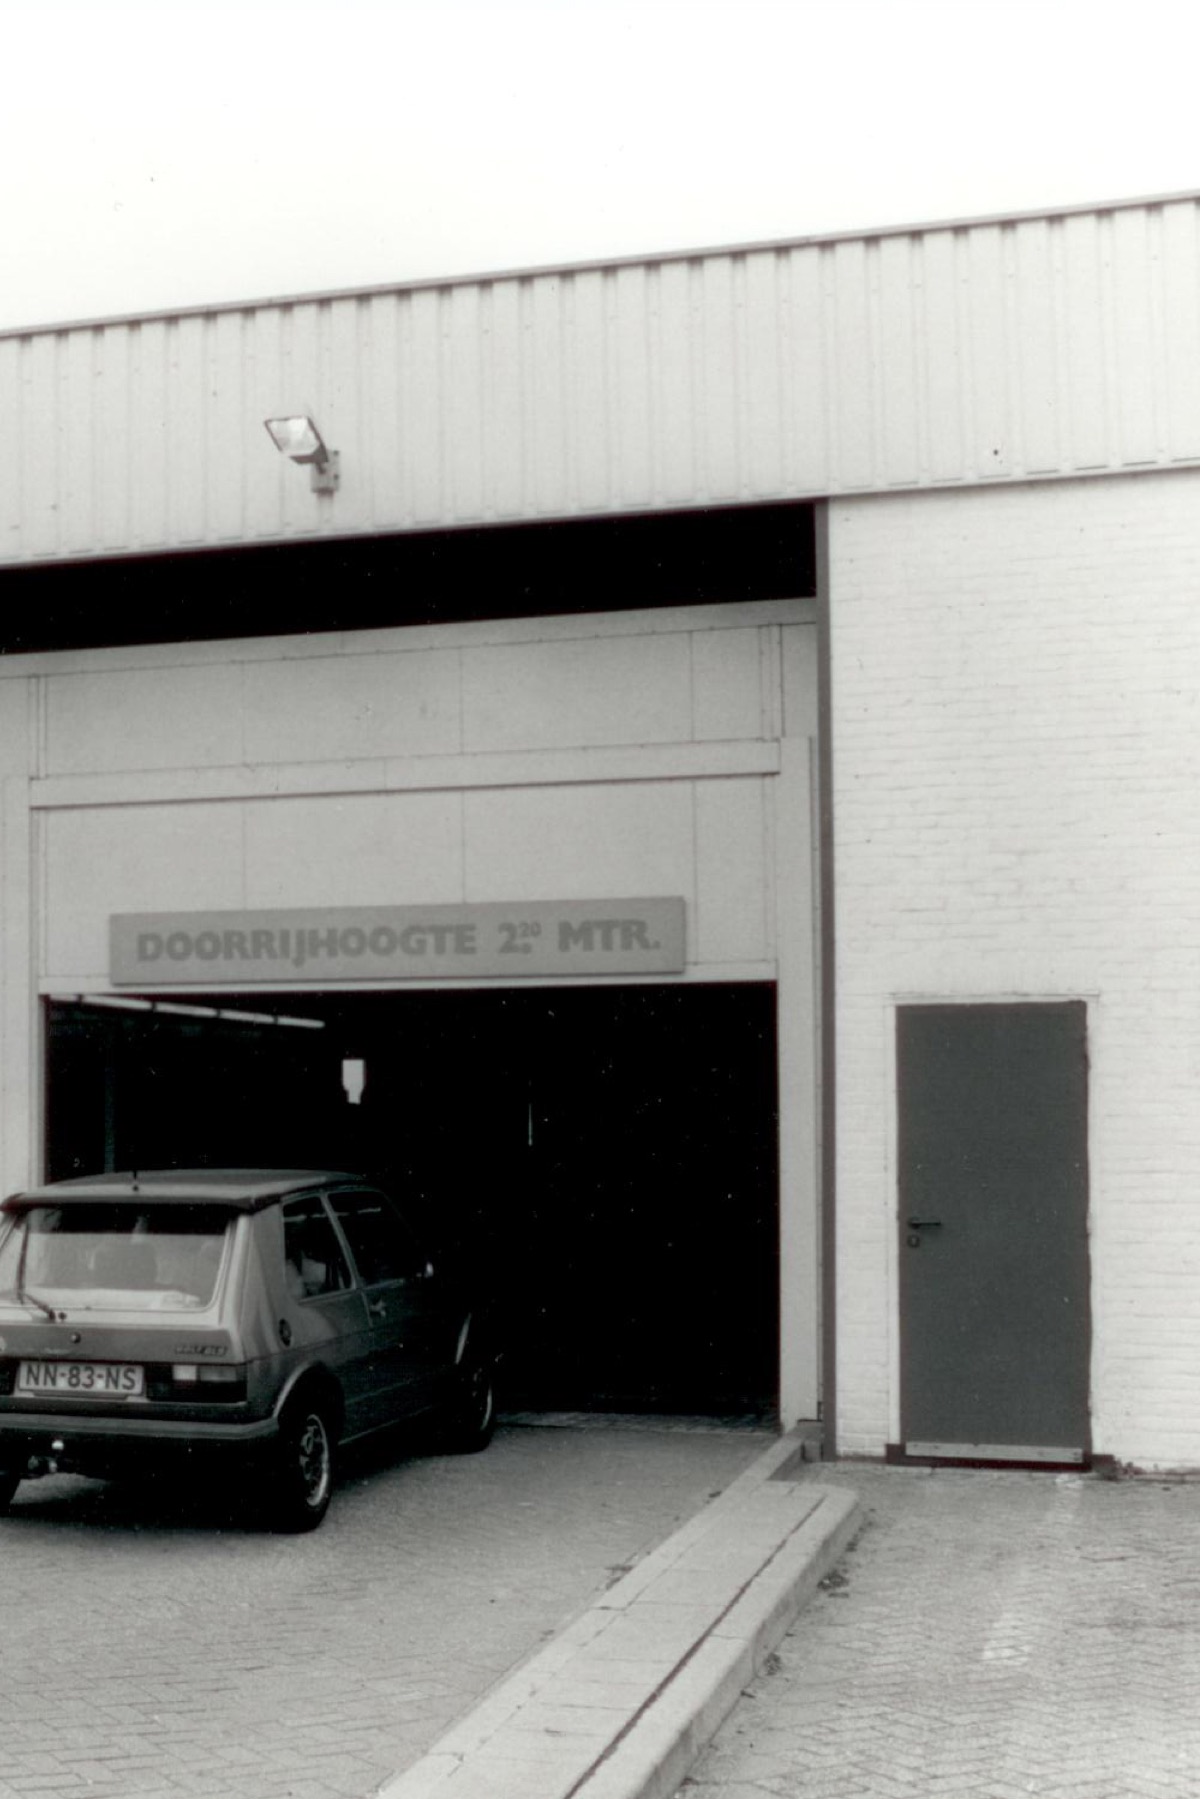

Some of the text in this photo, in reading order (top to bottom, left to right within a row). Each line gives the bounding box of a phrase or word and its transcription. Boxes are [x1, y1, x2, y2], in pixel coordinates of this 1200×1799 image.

[136, 923, 478, 968] DOORRIJHOOGTE
[557, 919, 662, 952] MTR.
[25, 1364, 137, 1391] NN-83-NS
